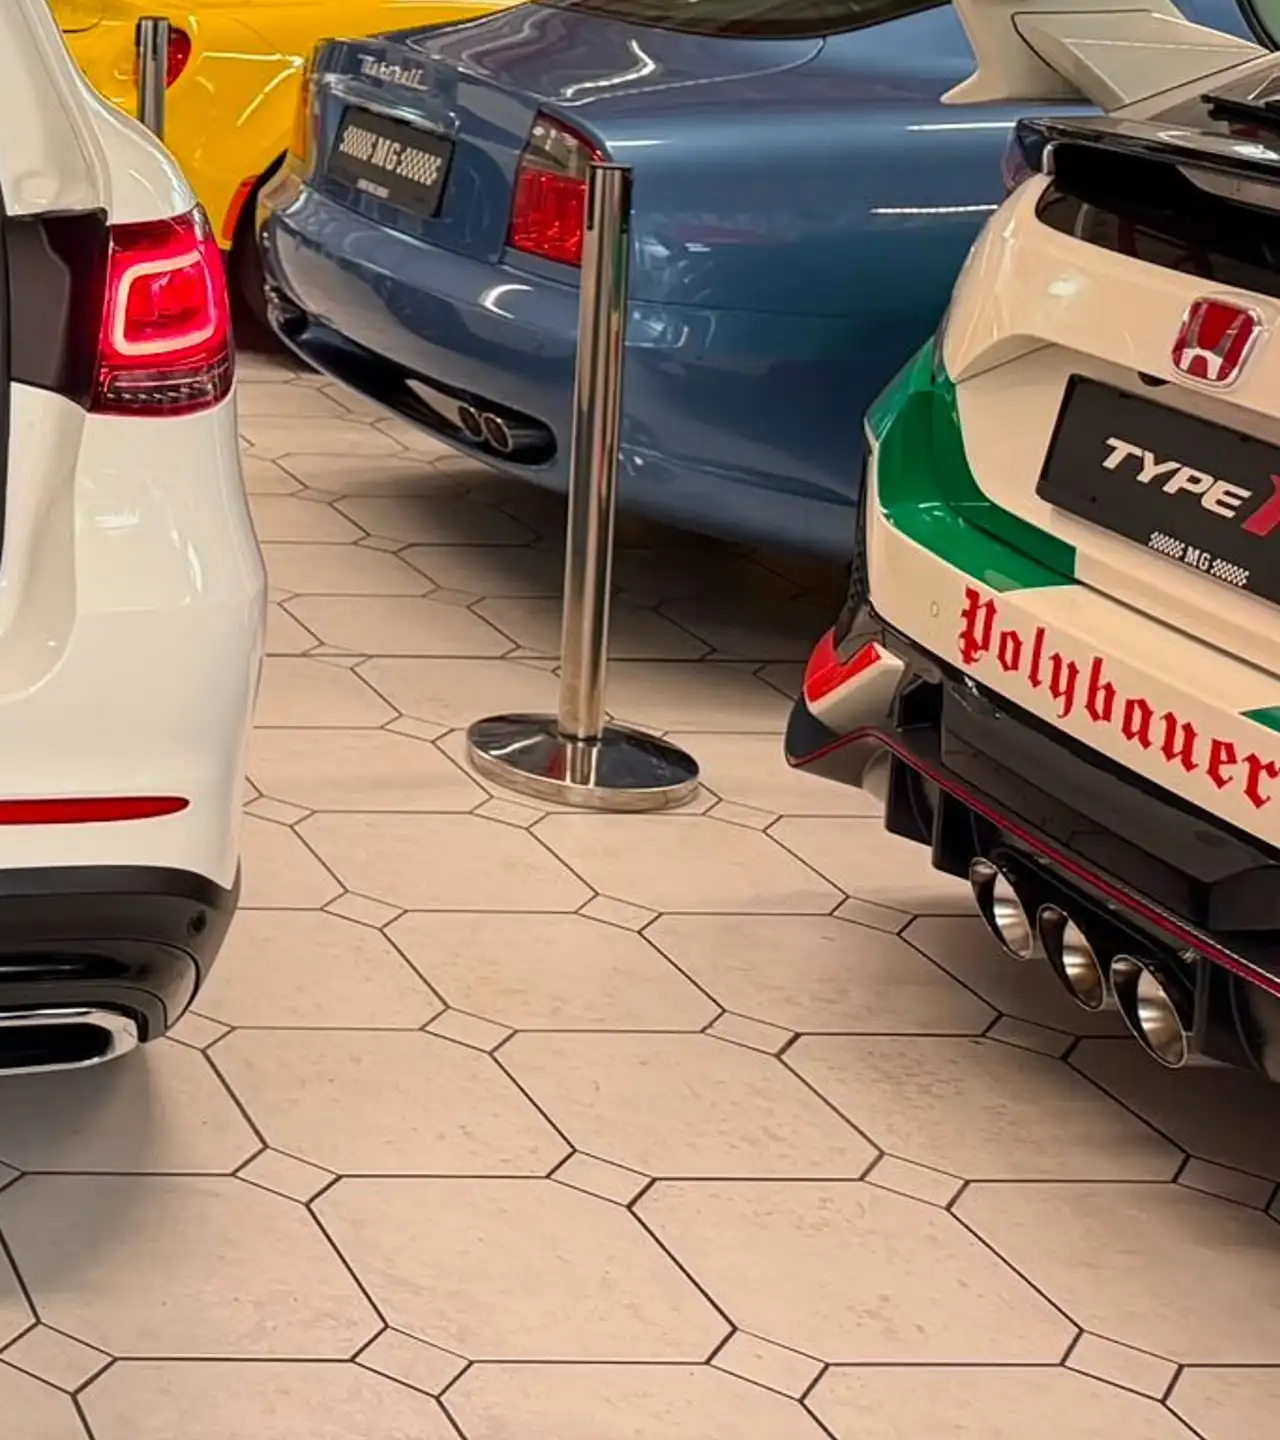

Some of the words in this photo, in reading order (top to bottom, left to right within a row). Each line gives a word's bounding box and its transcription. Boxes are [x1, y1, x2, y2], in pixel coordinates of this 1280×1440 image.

[370, 136, 401, 171] MG
[1101, 436, 1254, 519] TYPE
[1183, 545, 1212, 571] MG
[958, 584, 1280, 810] Polybauer
